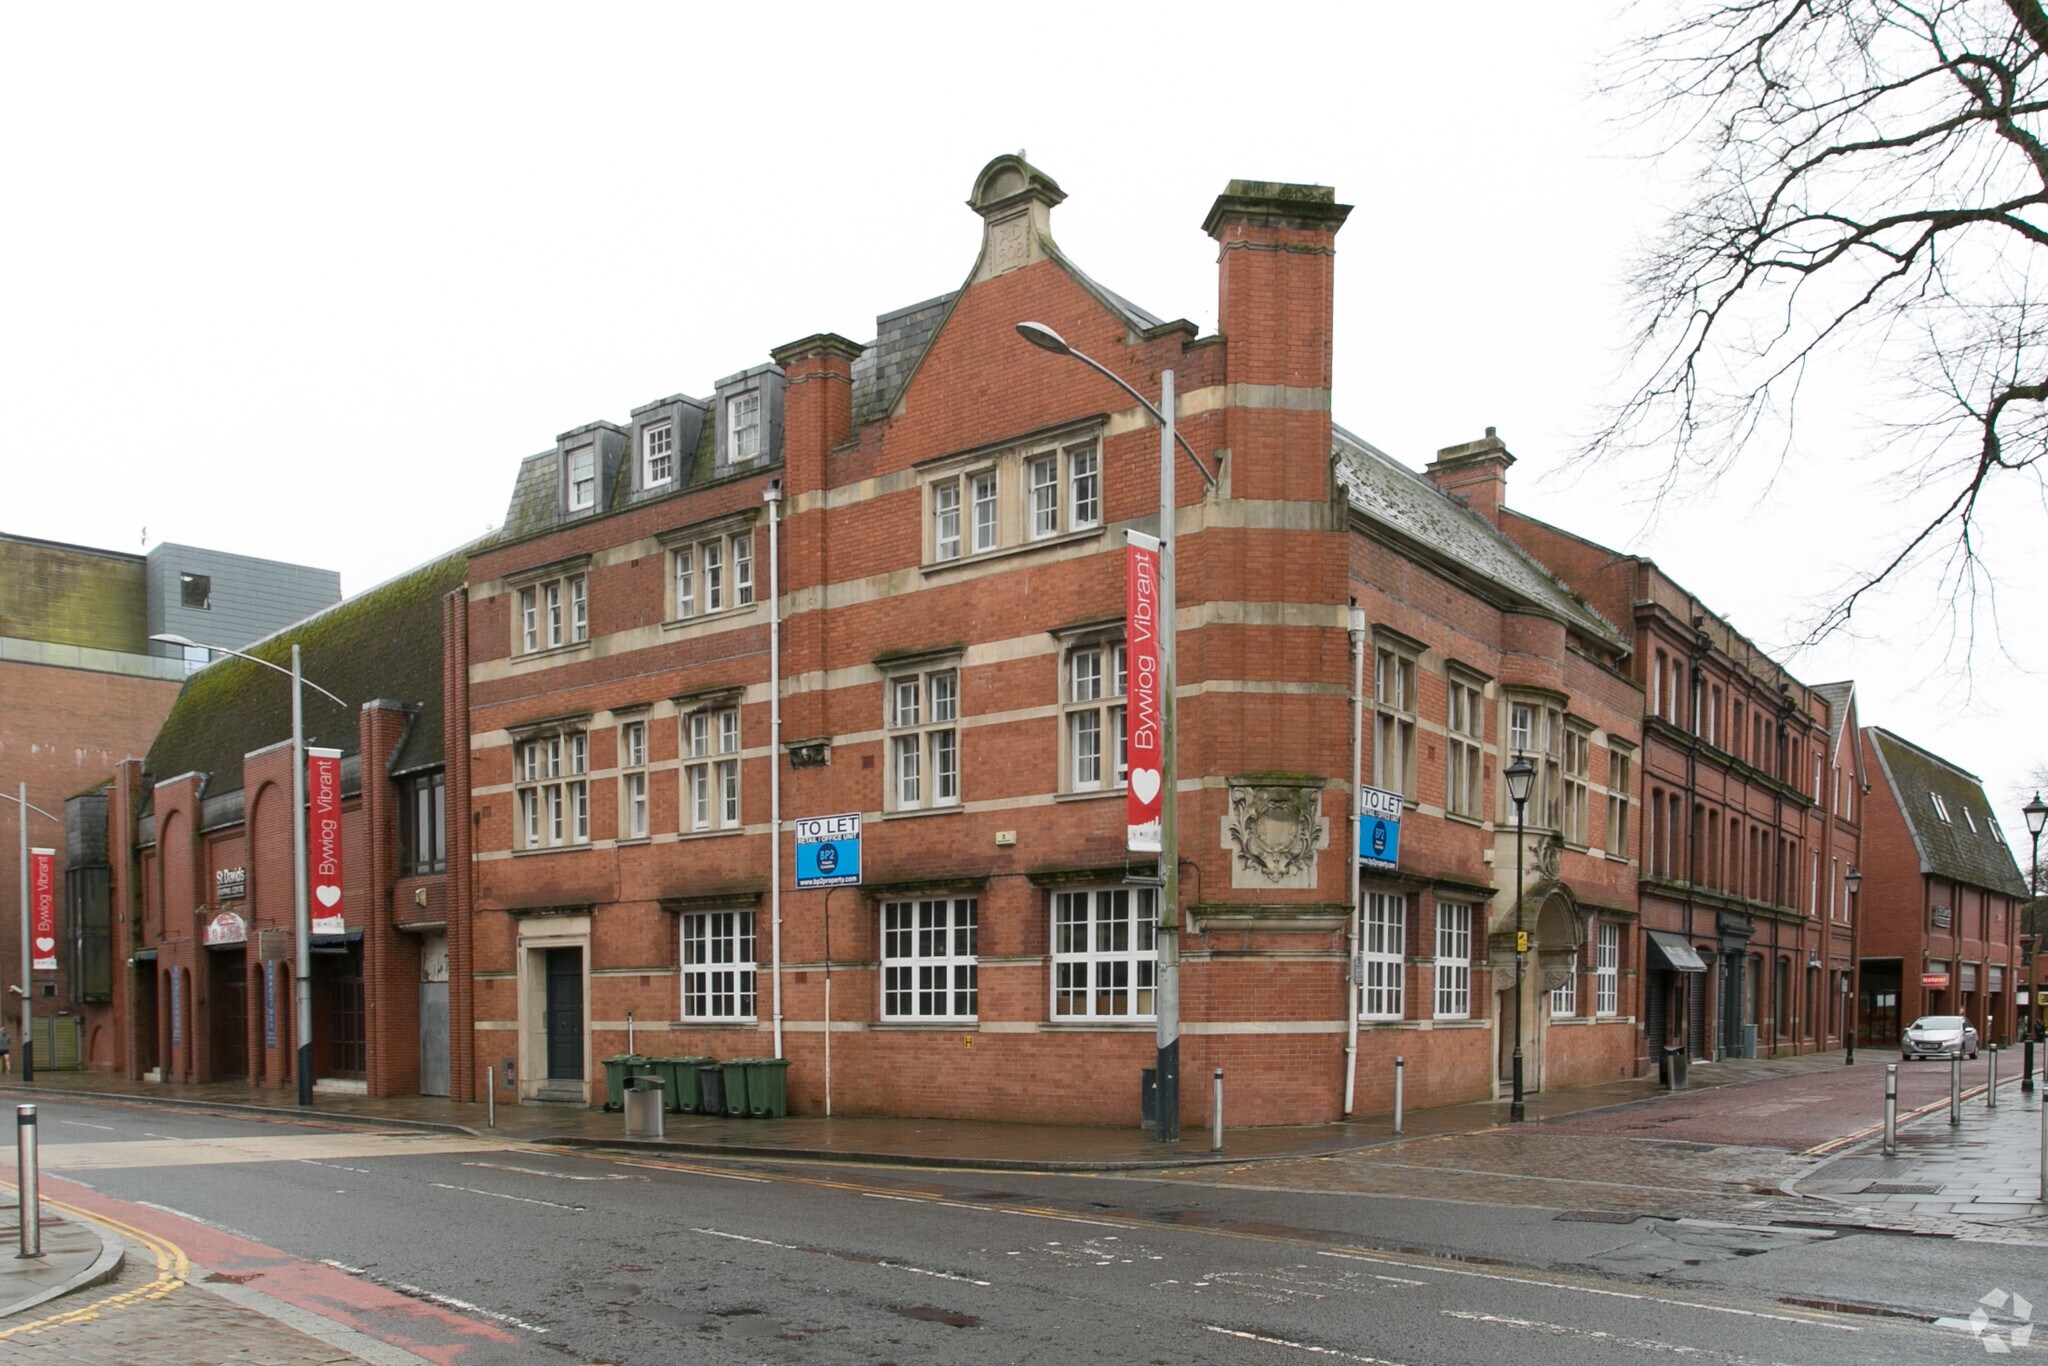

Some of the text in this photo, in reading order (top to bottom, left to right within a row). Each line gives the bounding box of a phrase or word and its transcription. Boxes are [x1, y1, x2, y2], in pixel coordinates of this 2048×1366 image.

[1134, 552, 1157, 750] Bywiog Vibrant
[1364, 790, 1402, 815] TO LET
[317, 760, 338, 875] Bywiog Vibrant
[799, 817, 858, 836] TO LET
[821, 834, 842, 842] OFFICE
[820, 850, 834, 860] BP2
[800, 876, 857, 886] www.bp2property.com
[38, 856, 52, 931] Bywiog Vibrant
[965, 1037, 972, 1048] H
